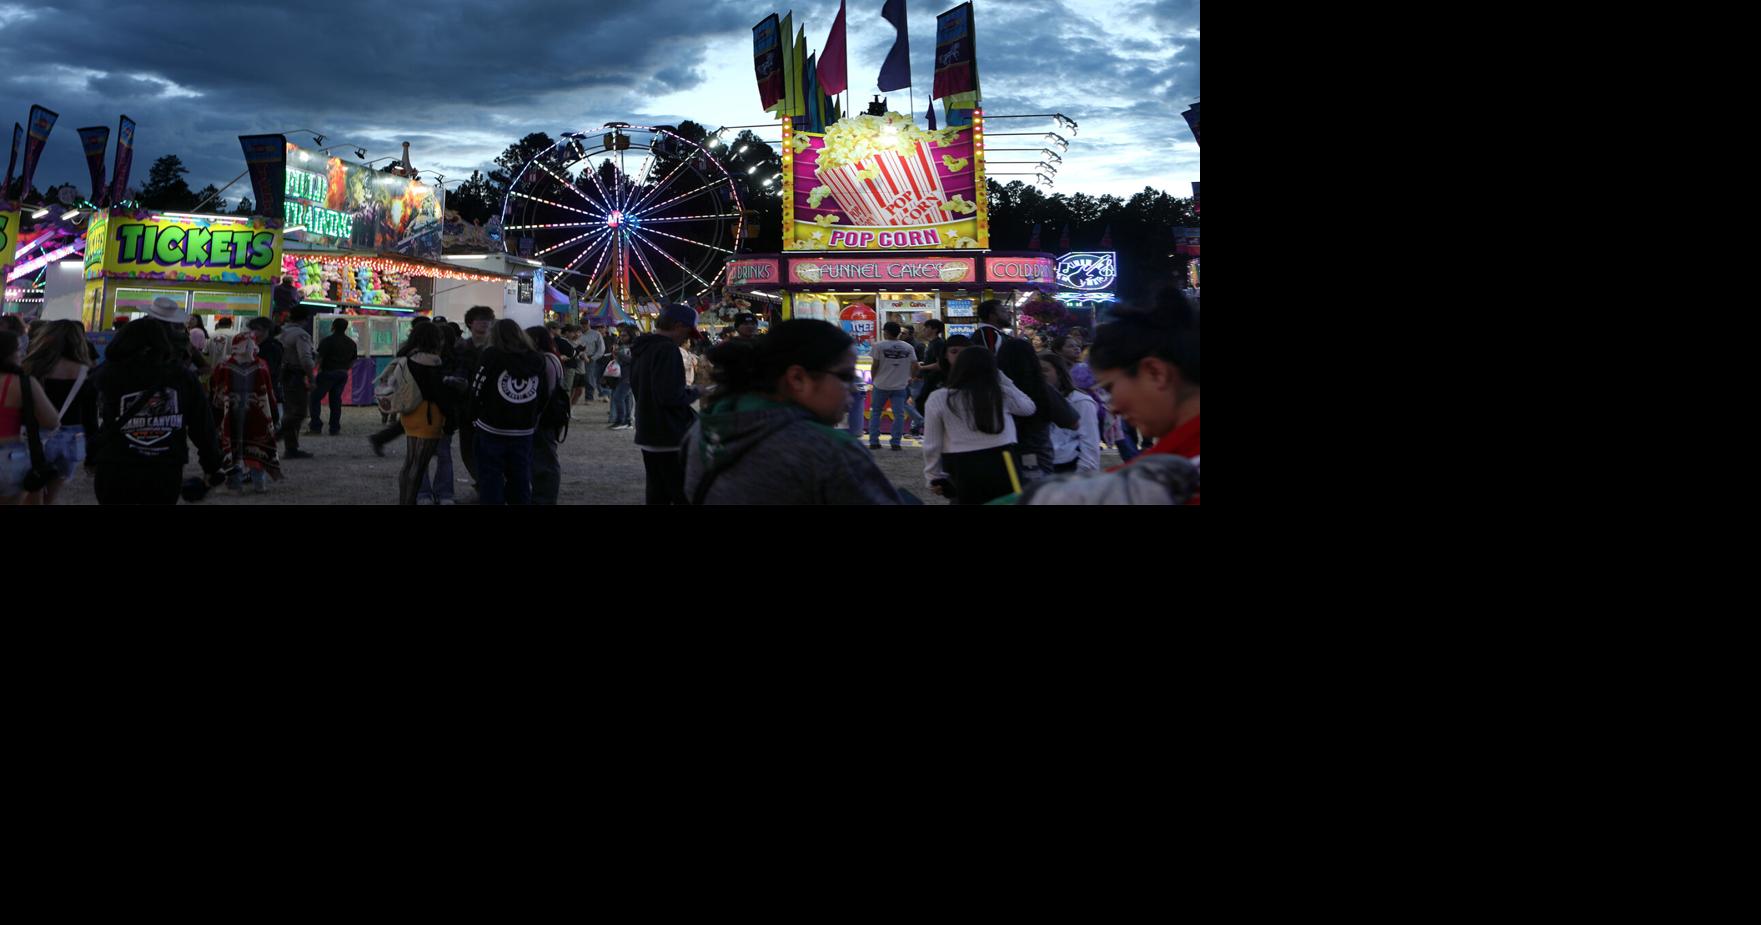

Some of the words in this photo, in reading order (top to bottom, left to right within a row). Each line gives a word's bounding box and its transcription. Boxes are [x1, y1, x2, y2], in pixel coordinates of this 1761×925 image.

[885, 190, 912, 216] POP
[283, 200, 354, 239] TRAINING
[829, 229, 874, 247] POP
[878, 228, 941, 247] CORN
[118, 224, 274, 268] TICKETS
[737, 264, 770, 278] DRINKS
[820, 263, 882, 278] FUNNEL
[887, 263, 943, 278] CAKES
[993, 262, 1032, 277] COLD
[851, 321, 874, 332] ICEE
[147, 415, 183, 427] CANYON
